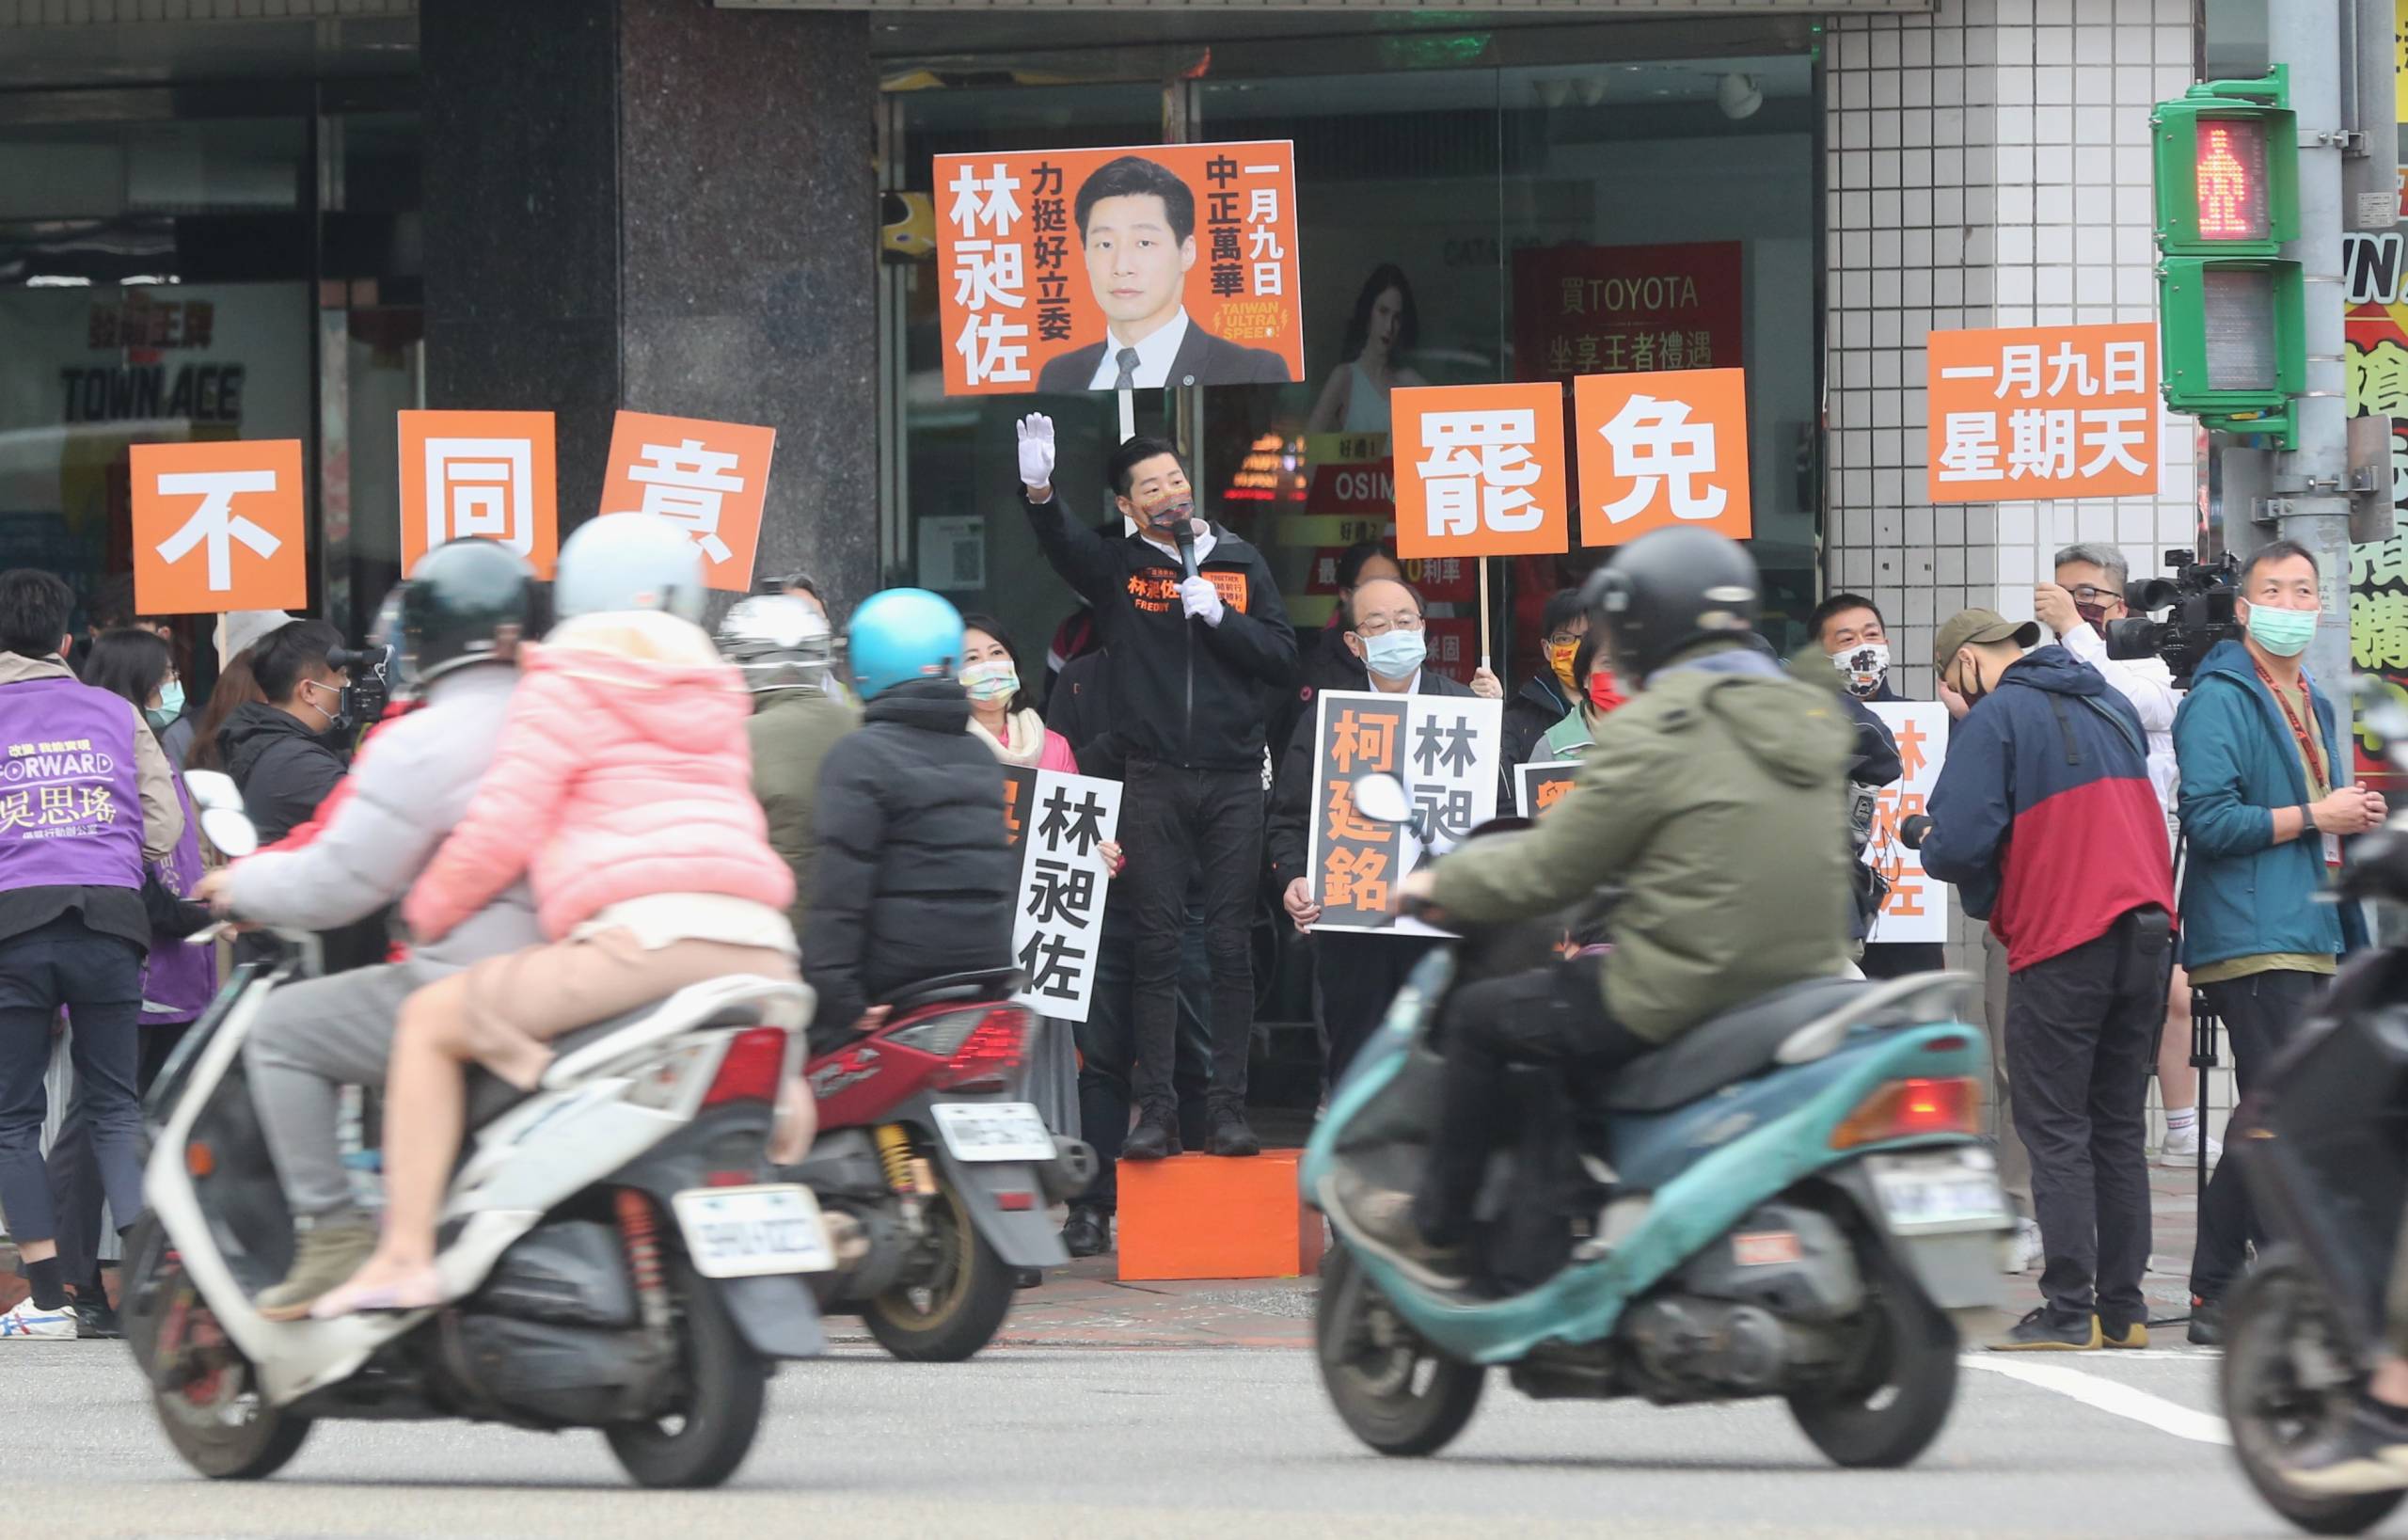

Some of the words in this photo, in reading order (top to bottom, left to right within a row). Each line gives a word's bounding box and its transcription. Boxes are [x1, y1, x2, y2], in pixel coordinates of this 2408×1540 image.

[948, 163, 1031, 386] 林昶佐
[1031, 162, 1072, 341] 力挺好立委
[1206, 154, 1244, 298] 中正萬華
[1244, 164, 1284, 296] 一月九日
[1221, 301, 1279, 315] TAIWAN
[1227, 314, 1277, 327] ULTRA
[1548, 330, 1713, 373] 坐享王者禮遇
[60, 366, 166, 421] TOWN
[167, 363, 246, 421] ACE
[1941, 341, 2146, 400] 一月九日
[425, 438, 533, 558] 同
[627, 438, 744, 564] 意
[1416, 408, 1545, 537] 罷
[1598, 393, 1727, 525] 免
[1939, 407, 2148, 483] 星期天
[155, 470, 282, 592] 不
[0, 786, 117, 834] 吳思瑤
[1019, 786, 1107, 1001] 林昶佐
